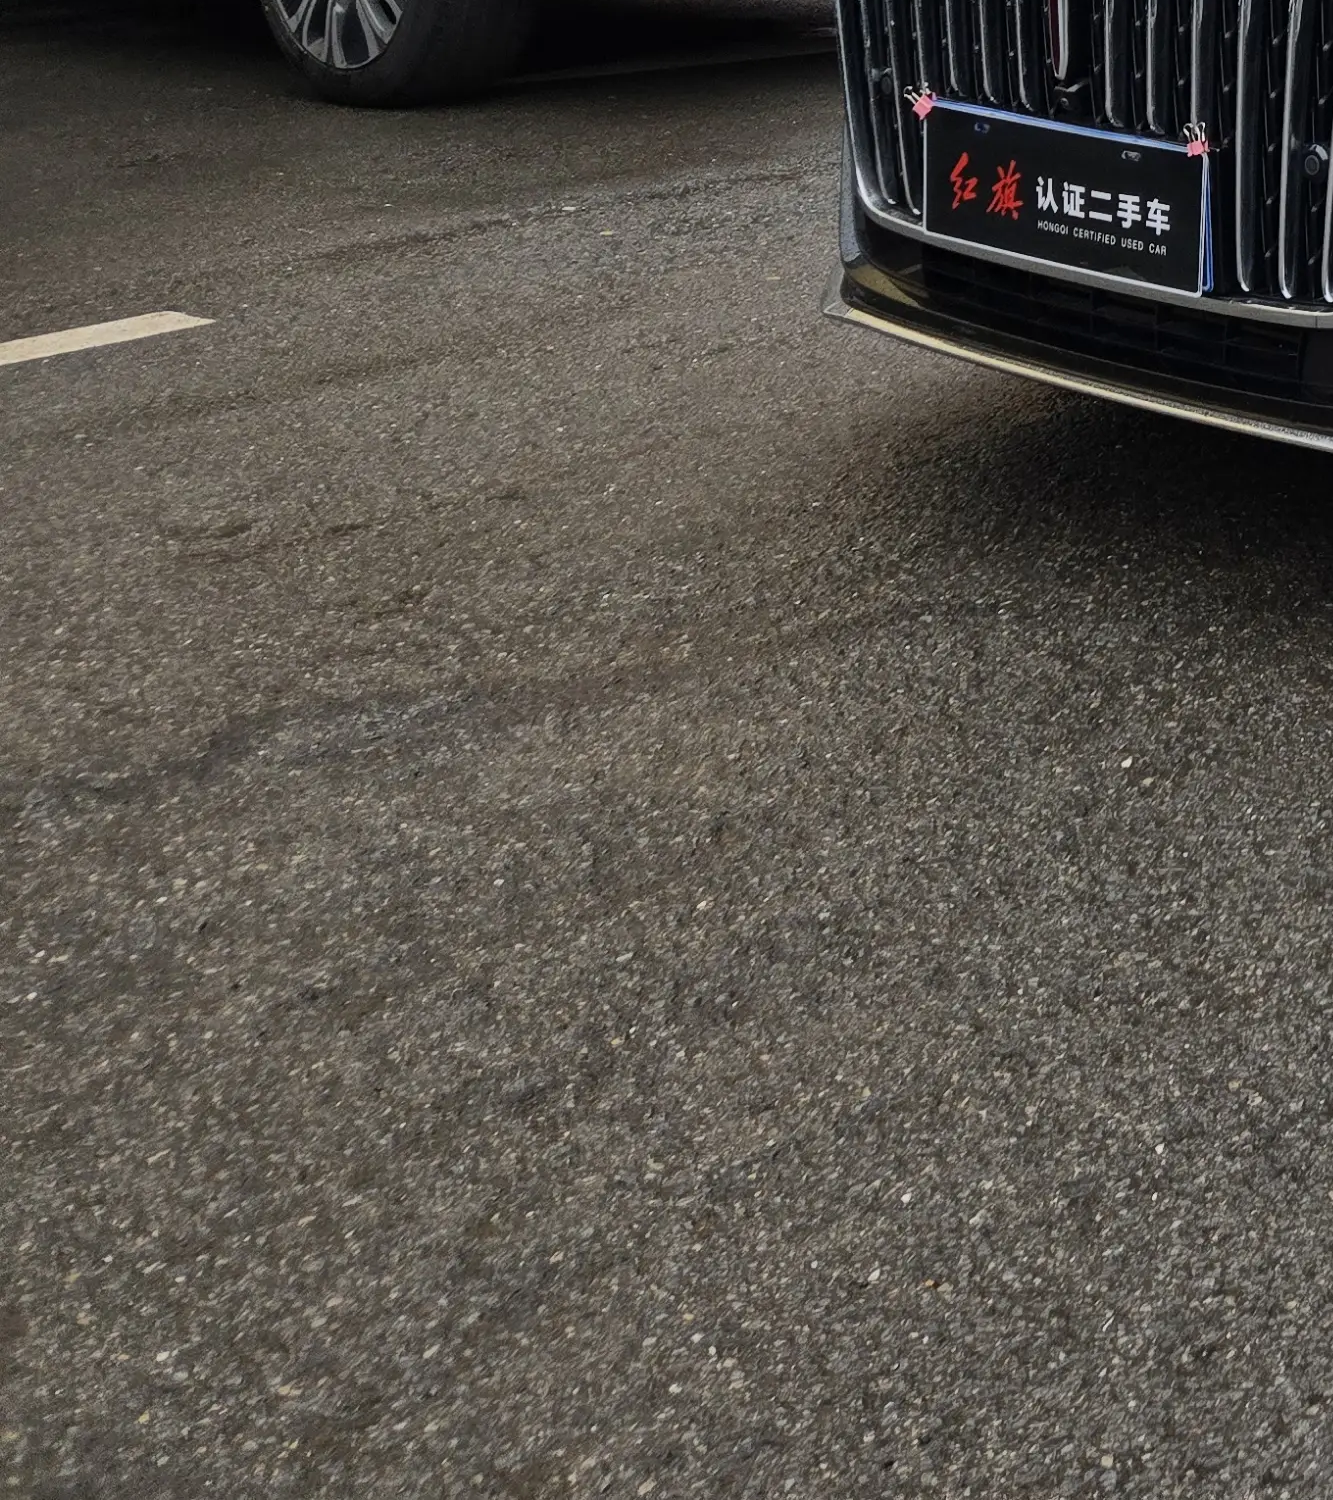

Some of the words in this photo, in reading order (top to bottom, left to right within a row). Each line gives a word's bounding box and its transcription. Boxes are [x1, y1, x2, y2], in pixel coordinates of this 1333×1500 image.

[950, 152, 1025, 220] 红旗
[1036, 176, 1171, 236] 认证二手车
[1073, 226, 1117, 246] CERTIFIED
[1121, 236, 1145, 252] USED
[1148, 243, 1167, 257] CAR
